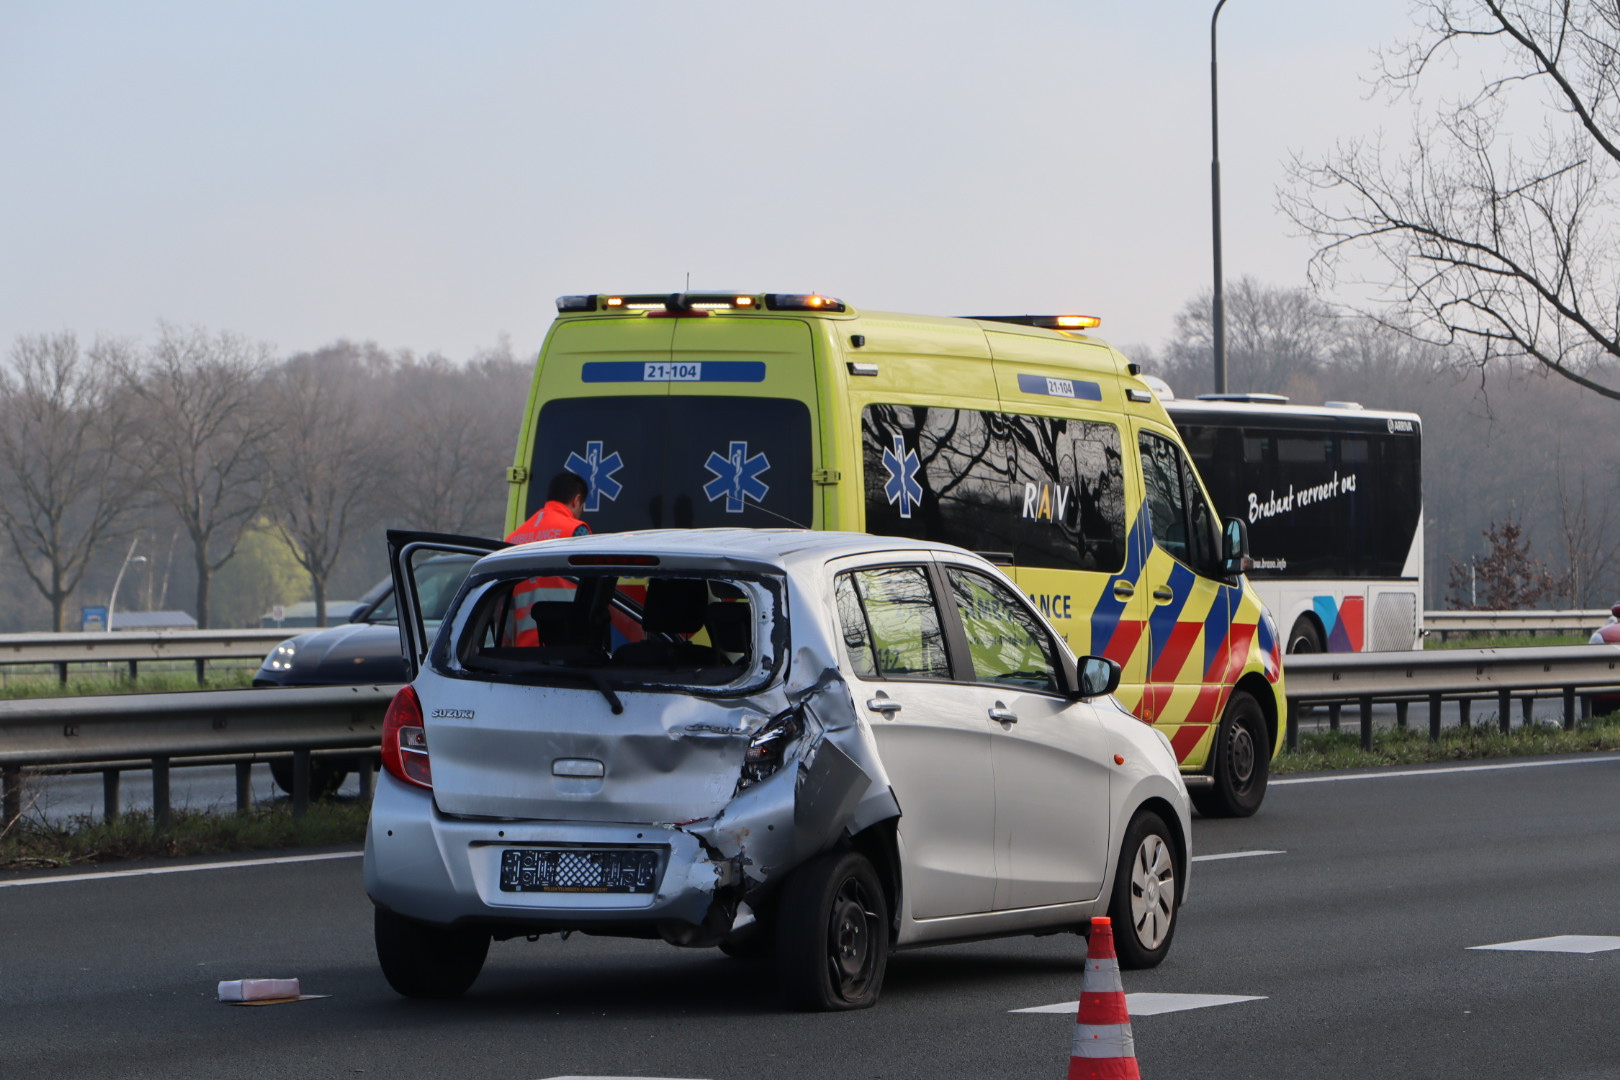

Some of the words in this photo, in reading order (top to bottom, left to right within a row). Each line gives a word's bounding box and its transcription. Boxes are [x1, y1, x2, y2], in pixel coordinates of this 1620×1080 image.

[647, 365, 697, 378] 21-104
[1048, 380, 1073, 394] 21-104
[1248, 484, 1294, 524] Brabant
[1297, 470, 1339, 508] vervoert
[1341, 474, 1356, 494] ons
[431, 709, 475, 719] SUZUKI
